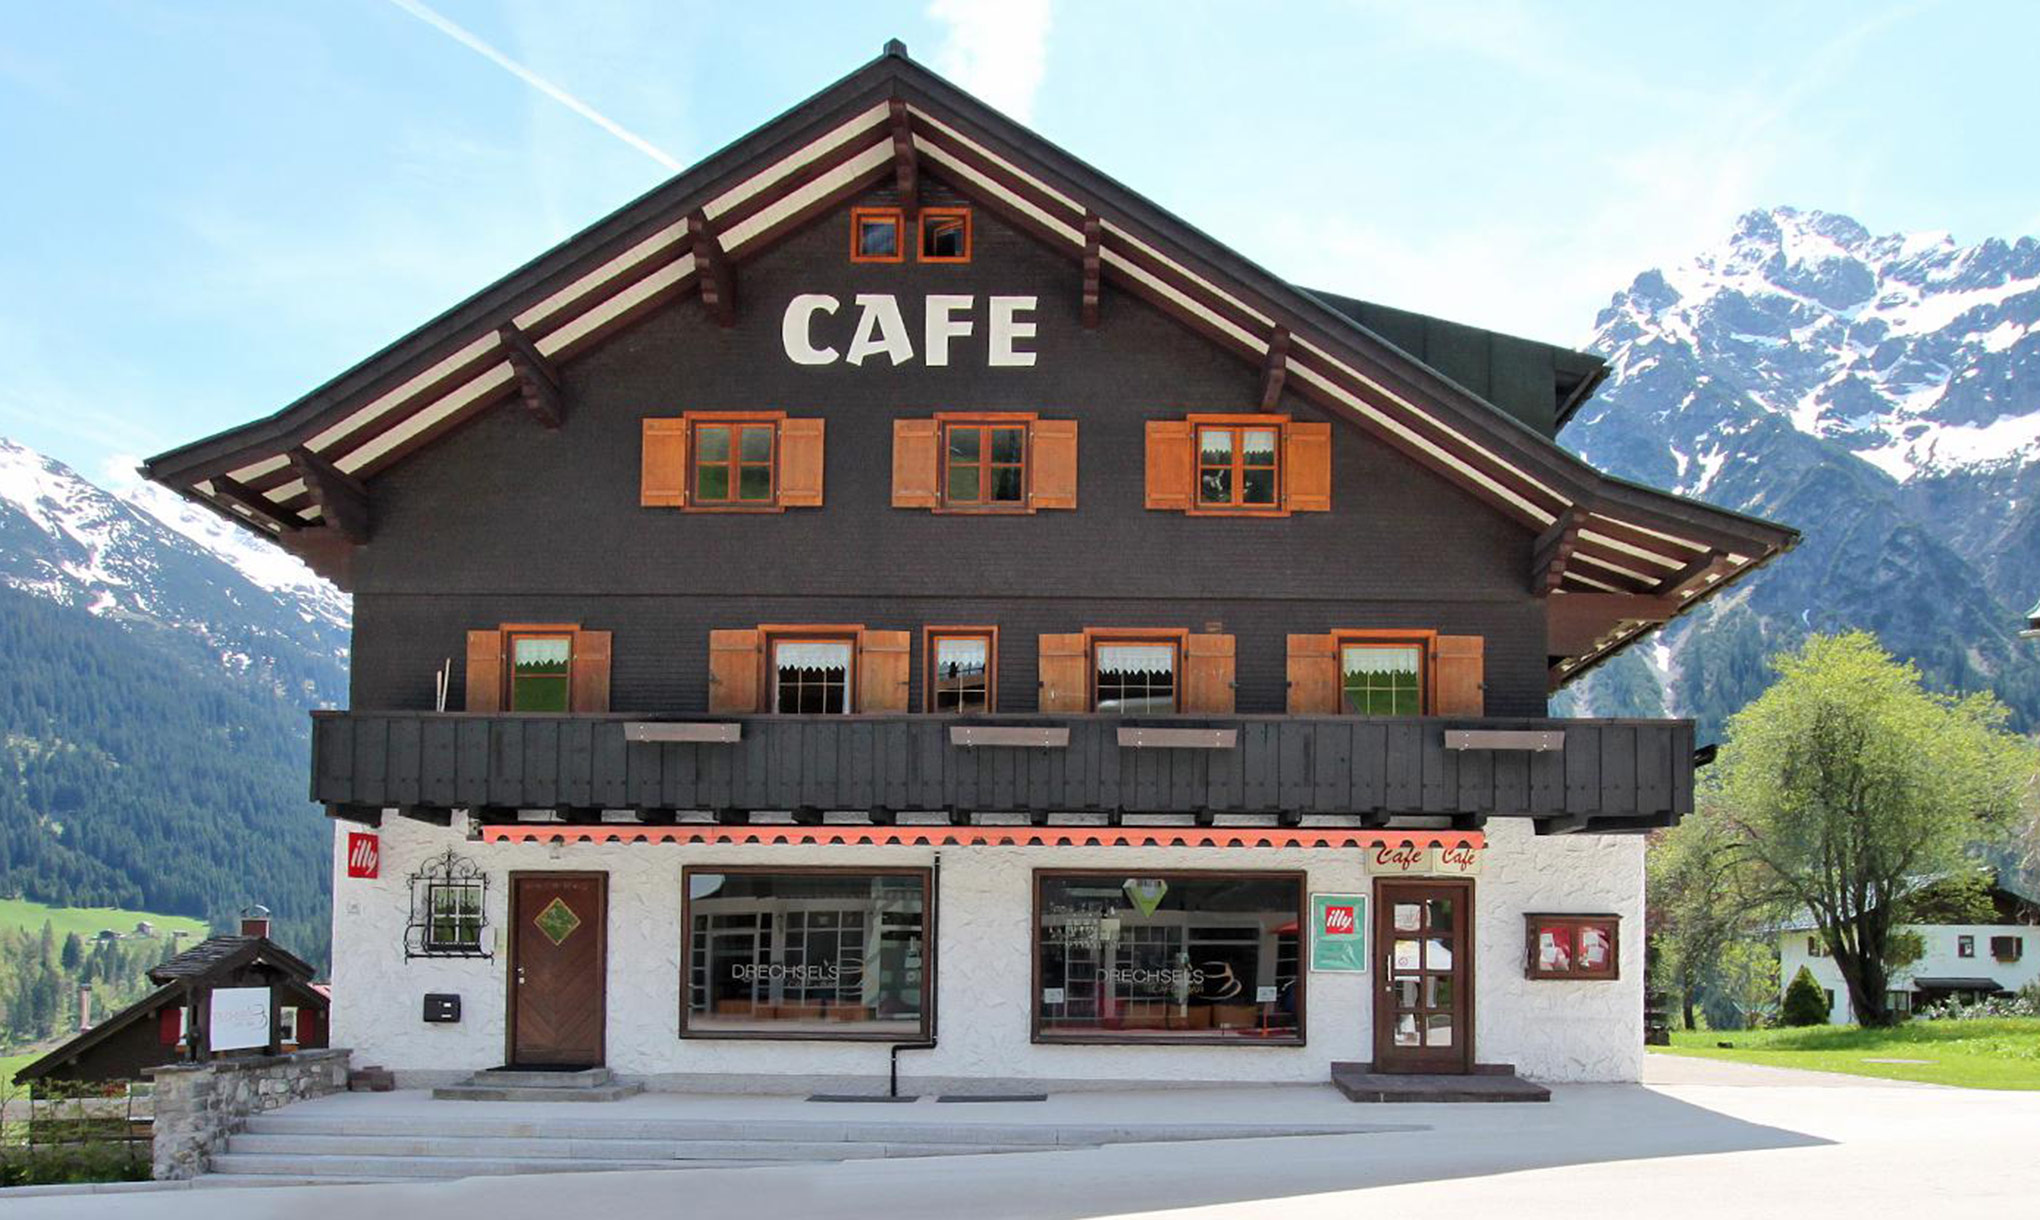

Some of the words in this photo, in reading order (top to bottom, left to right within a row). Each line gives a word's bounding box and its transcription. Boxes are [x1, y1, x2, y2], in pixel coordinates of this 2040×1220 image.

[782, 293, 1038, 367] CAFE
[351, 839, 377, 875] illy
[1326, 909, 1352, 932] illy
